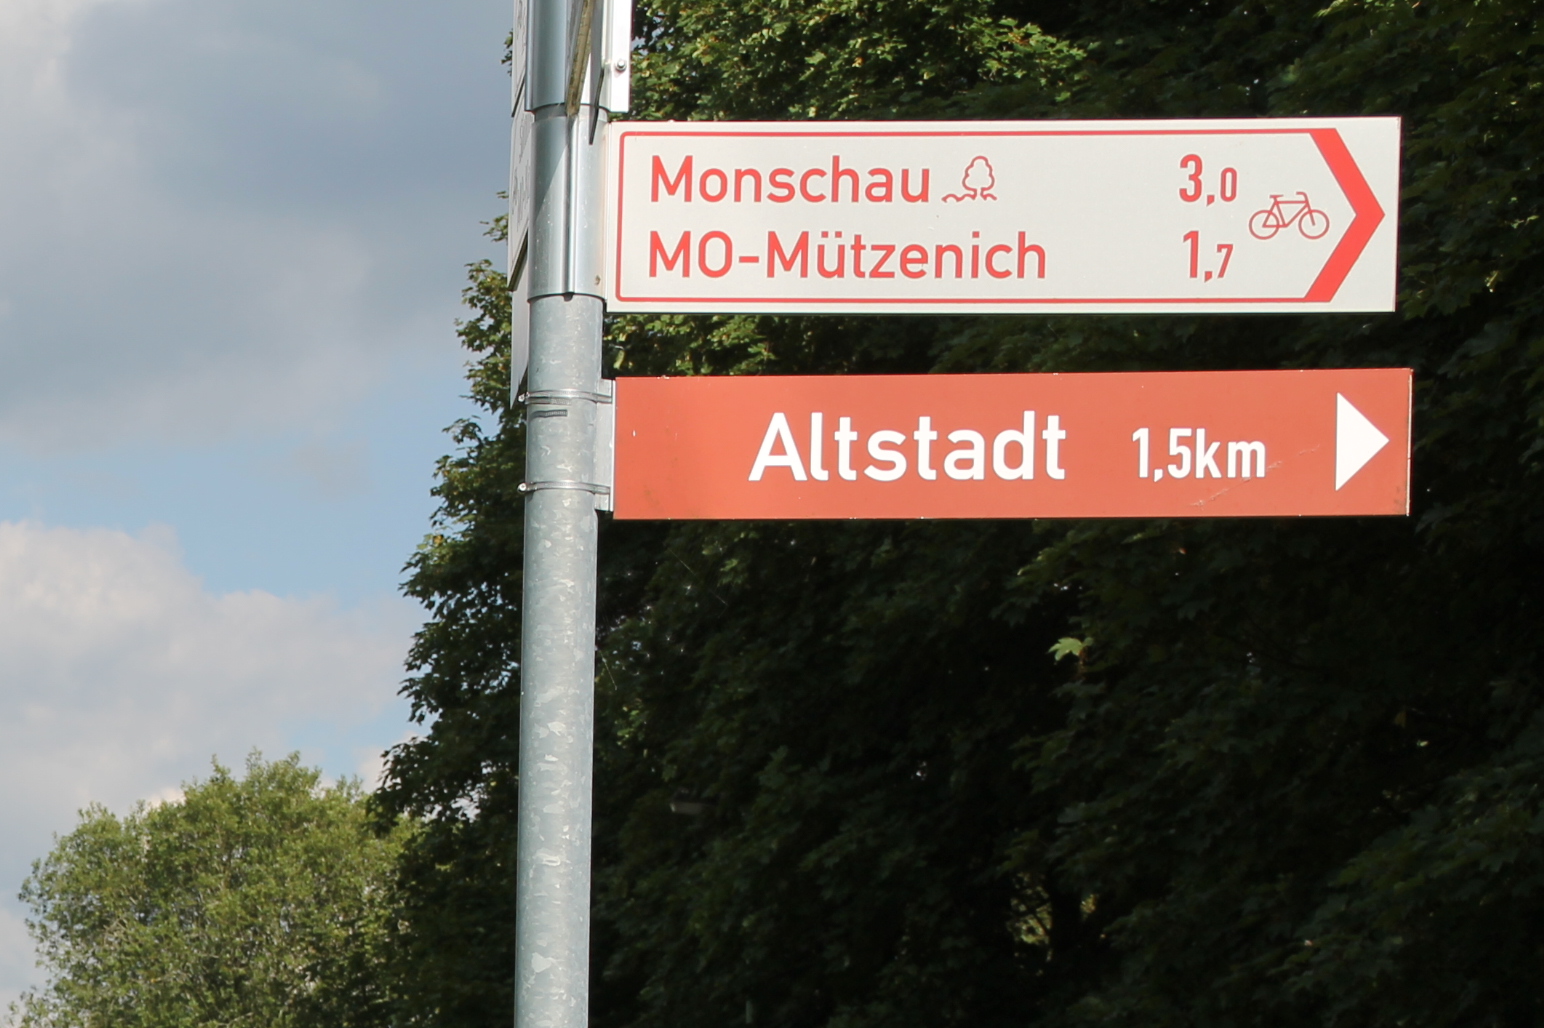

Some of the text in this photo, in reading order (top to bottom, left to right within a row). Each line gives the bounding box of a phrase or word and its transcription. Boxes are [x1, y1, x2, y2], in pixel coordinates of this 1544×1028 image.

[651, 154, 1238, 205] Monschau 3,0
[649, 230, 1234, 281] MO-Mützenich 1,7
[748, 410, 1267, 483] Altstadt 1,5km
